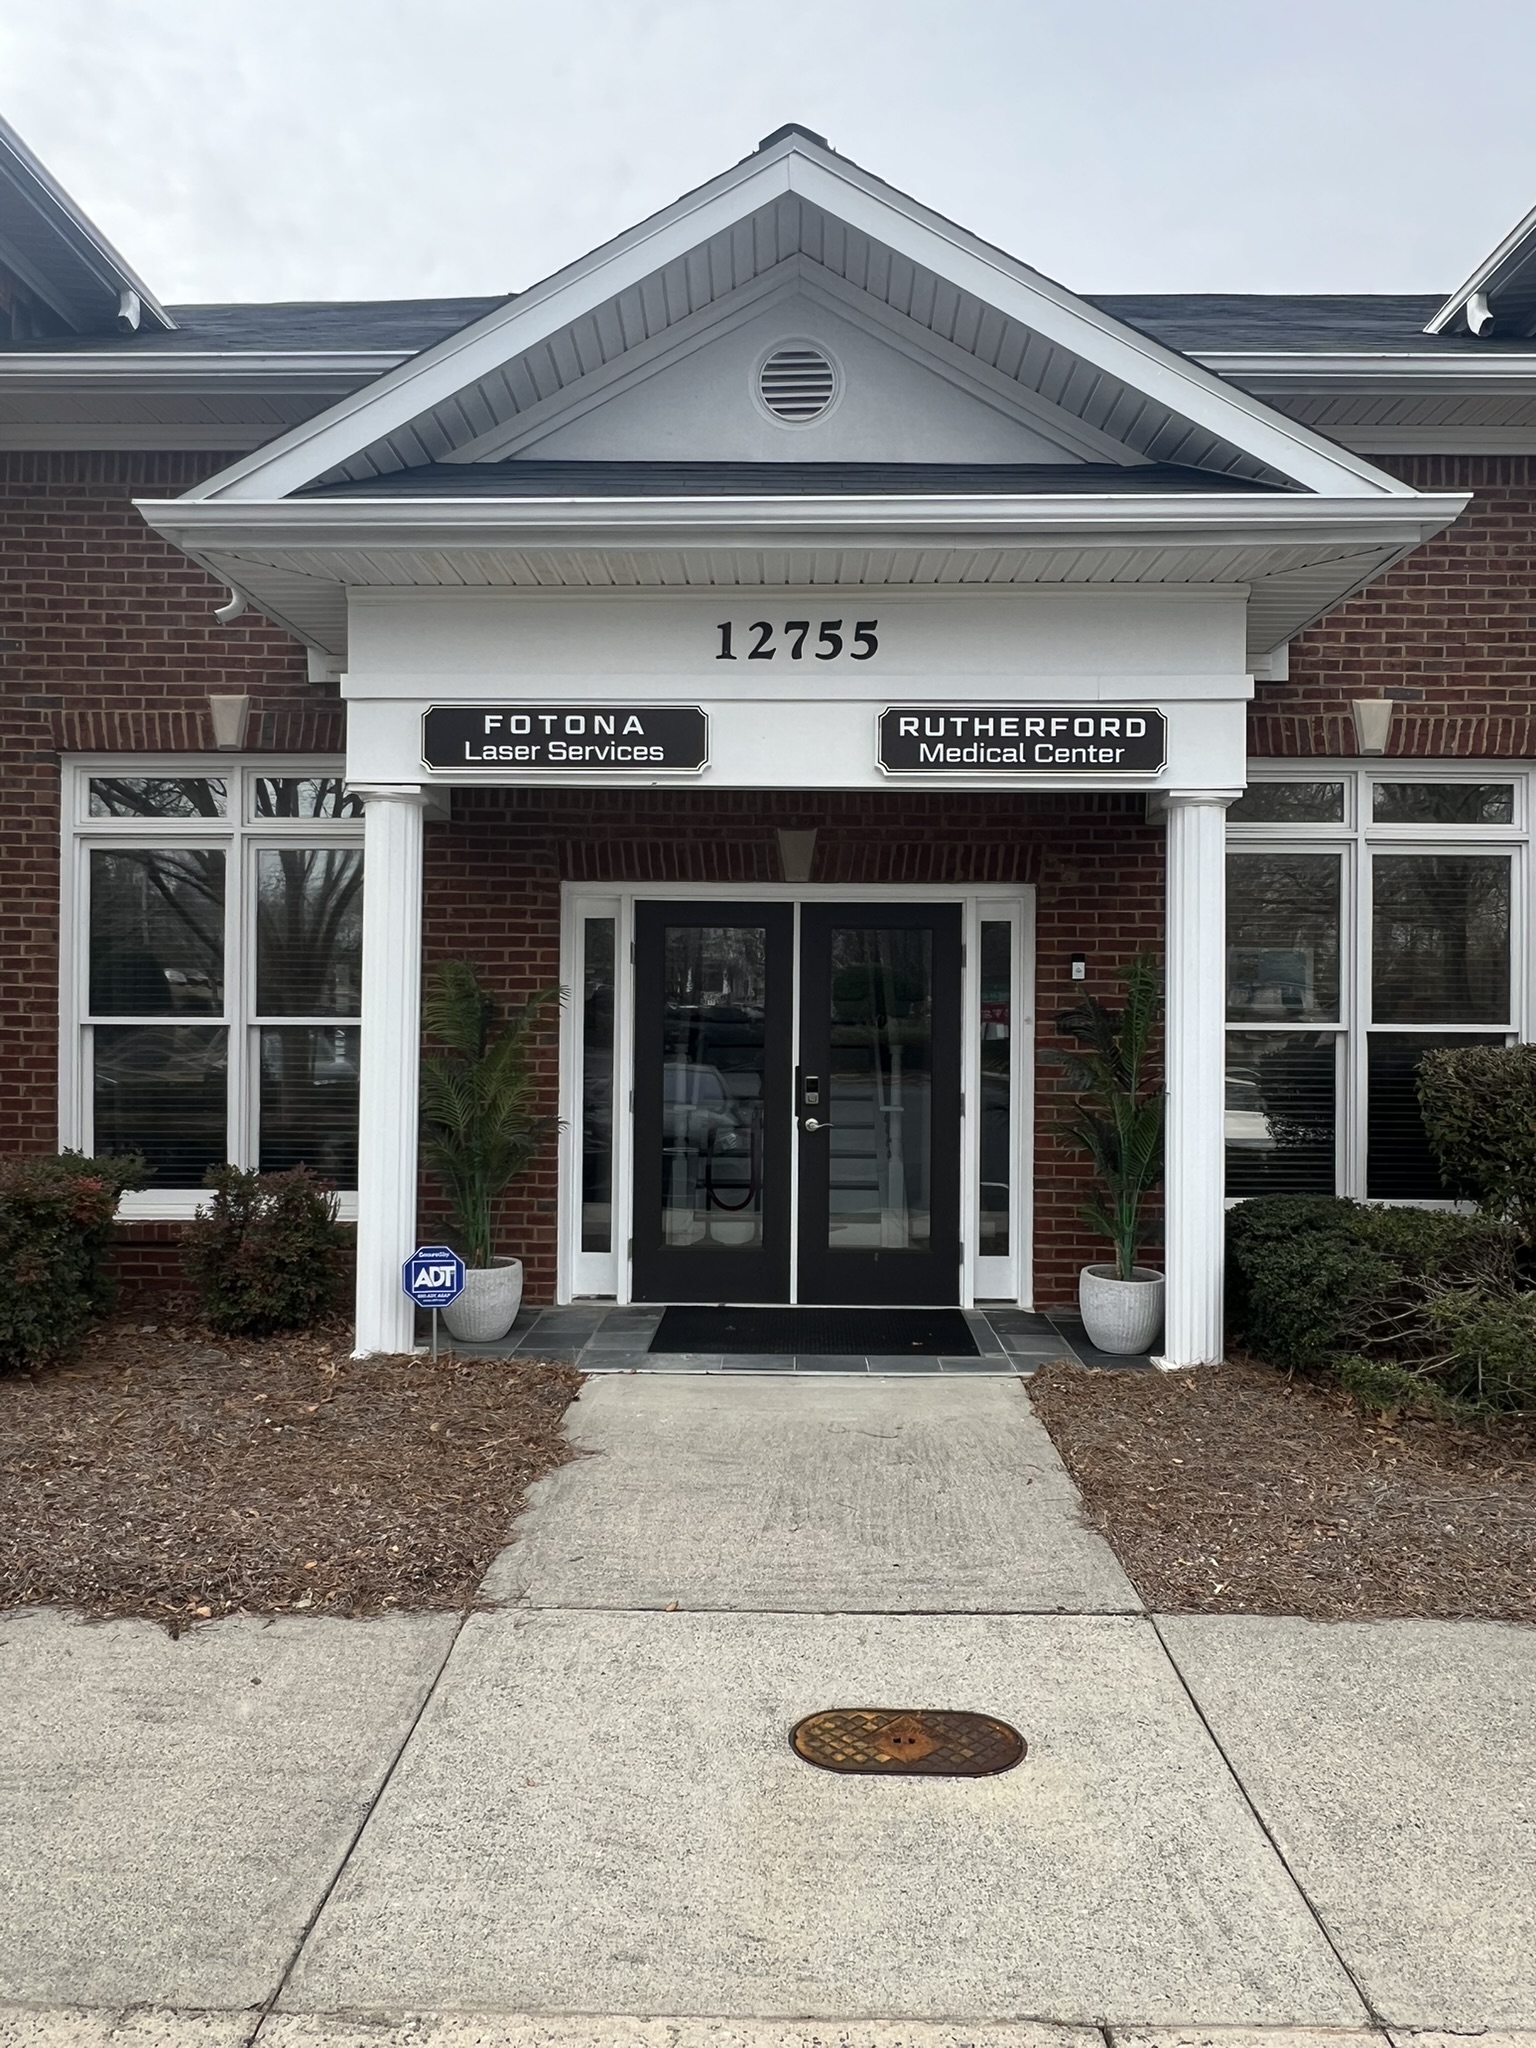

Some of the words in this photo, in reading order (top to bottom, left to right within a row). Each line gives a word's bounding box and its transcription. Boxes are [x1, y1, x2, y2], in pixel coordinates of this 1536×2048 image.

[715, 620, 880, 661] 12755
[484, 714, 645, 735] FOTONA
[899, 716, 1147, 738] RUTHERFORD
[465, 740, 541, 761] Laser
[547, 741, 664, 761] Services
[919, 741, 1027, 763] Medical
[1034, 743, 1126, 763] Center
[414, 1265, 456, 1288] ADT
